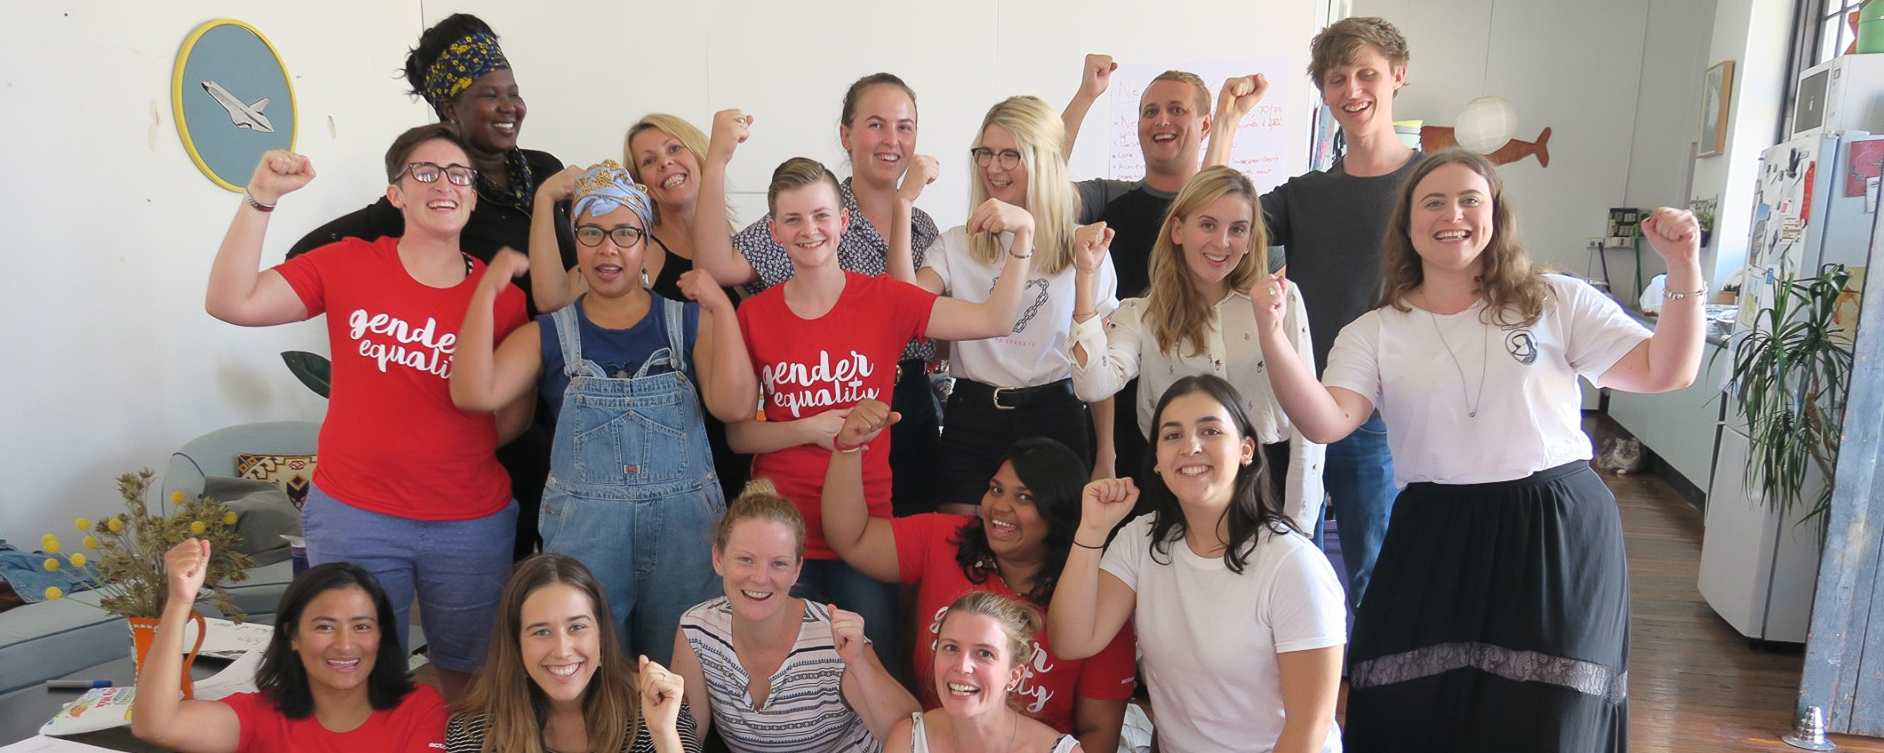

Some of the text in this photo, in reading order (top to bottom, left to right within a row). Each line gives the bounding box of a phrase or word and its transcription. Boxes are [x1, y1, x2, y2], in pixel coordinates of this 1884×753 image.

[349, 308, 457, 354] gende
[359, 339, 454, 378] equali
[762, 350, 874, 395] gender
